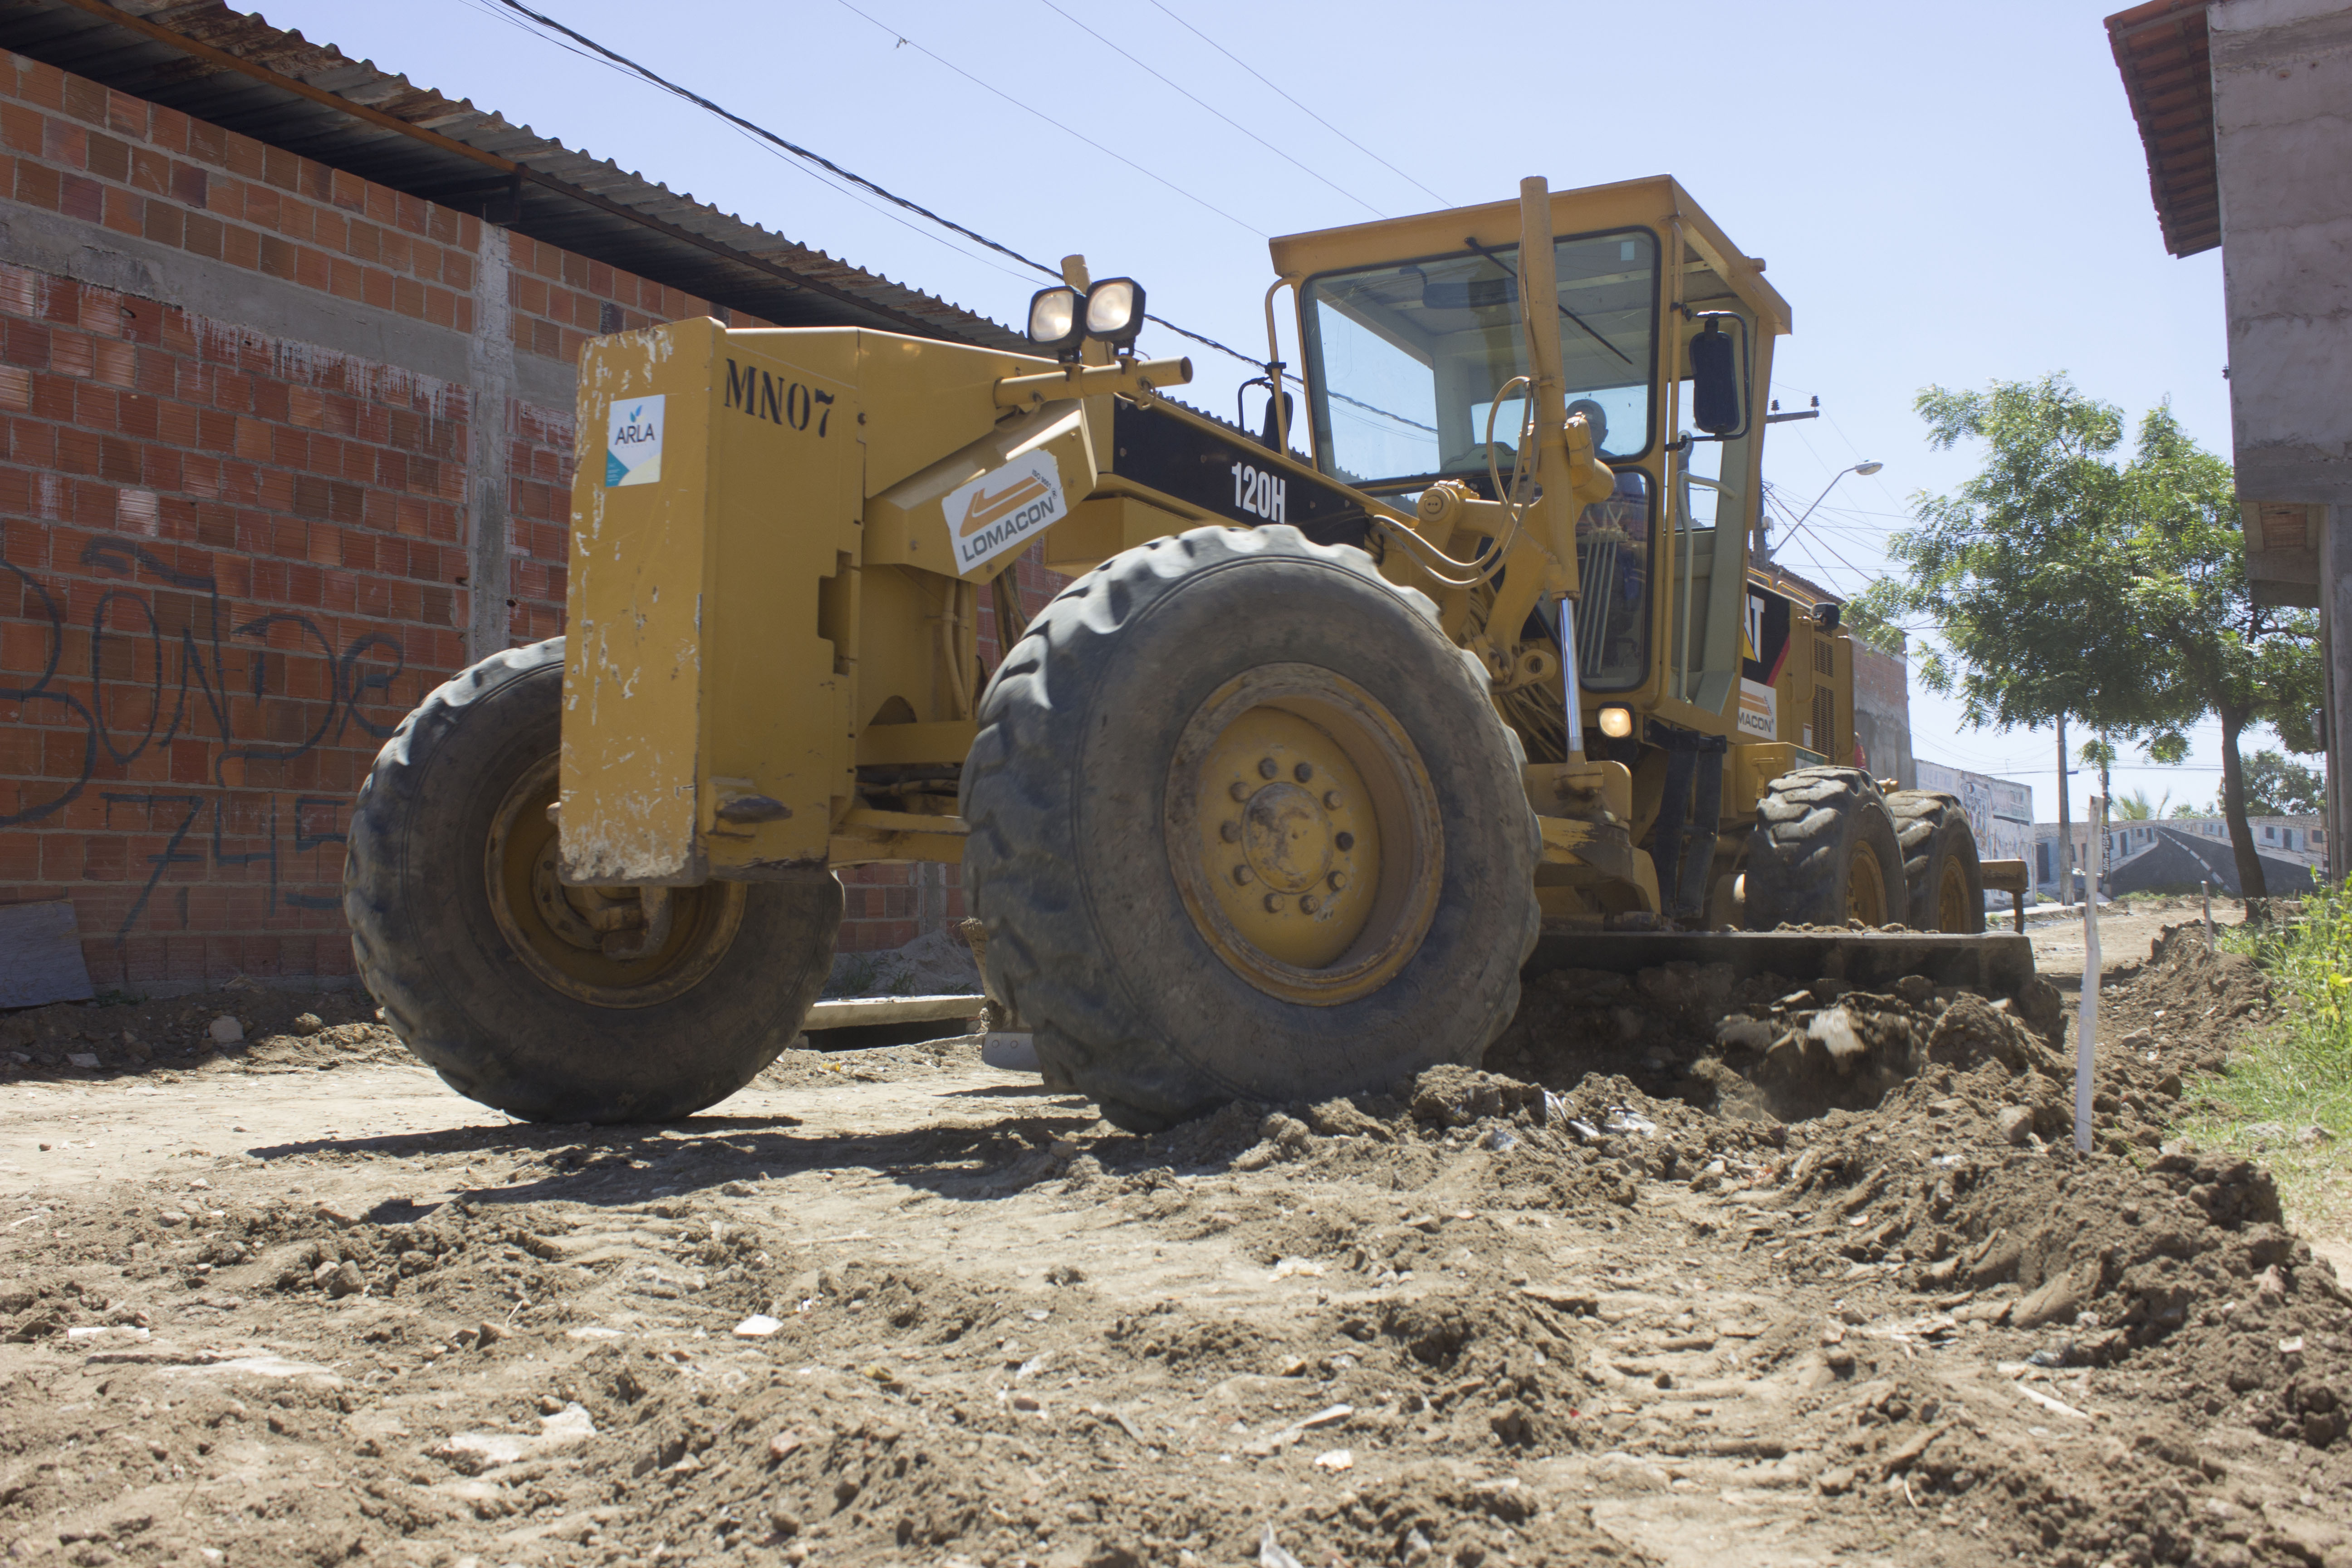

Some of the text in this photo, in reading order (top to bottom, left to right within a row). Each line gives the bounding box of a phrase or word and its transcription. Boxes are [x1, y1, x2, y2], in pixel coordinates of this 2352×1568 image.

[615, 423, 655, 445] ARLA
[1032, 469, 1041, 480] ISO
[1231, 462, 1285, 524] 120H
[962, 496, 1055, 562] LOMACON
